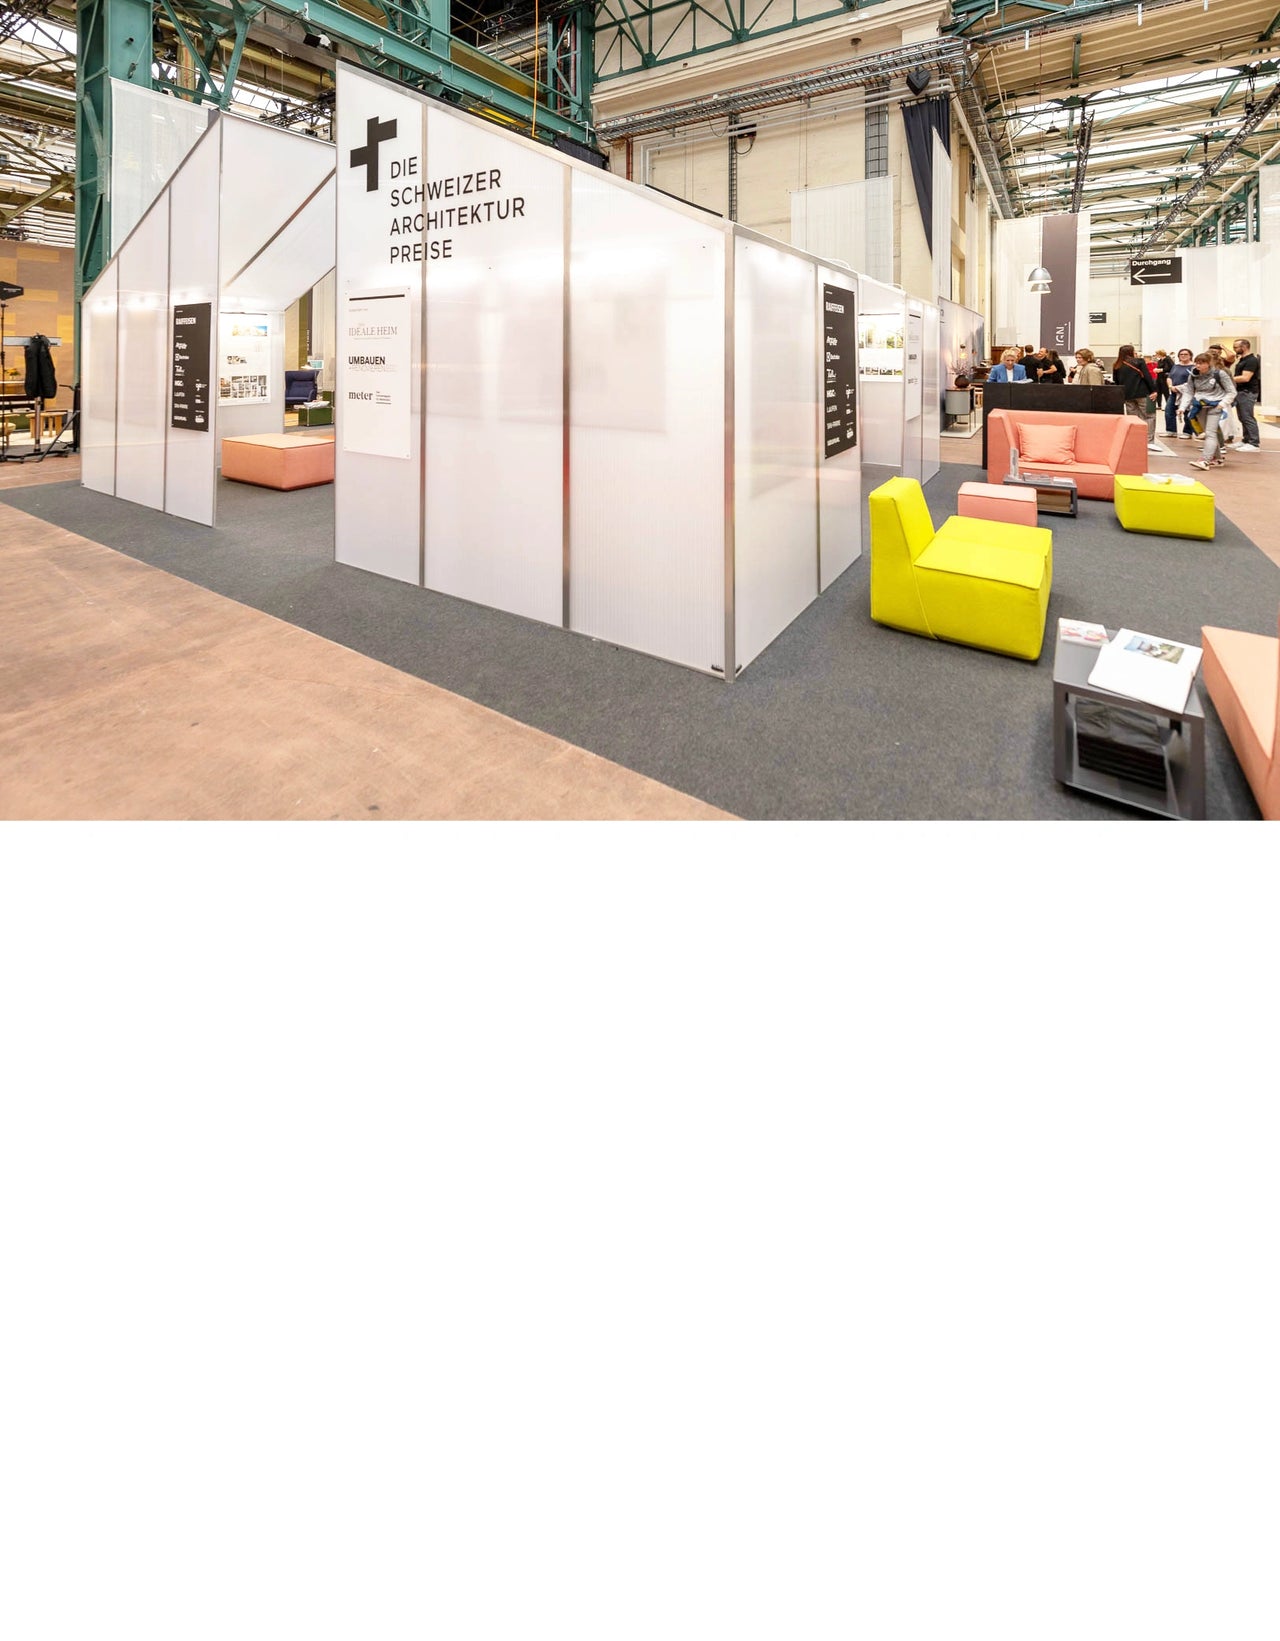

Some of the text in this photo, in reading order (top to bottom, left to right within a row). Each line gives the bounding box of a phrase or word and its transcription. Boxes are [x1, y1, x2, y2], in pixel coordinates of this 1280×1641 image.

[390, 156, 418, 179] DIE
[390, 168, 502, 207] SCHWEIZER
[389, 196, 526, 236] ARCHITEKTUR
[390, 239, 453, 264] PREISE
[348, 326, 398, 336] IDEALE HEIM
[348, 356, 386, 365] UMBAUEN
[348, 391, 374, 401] meter
